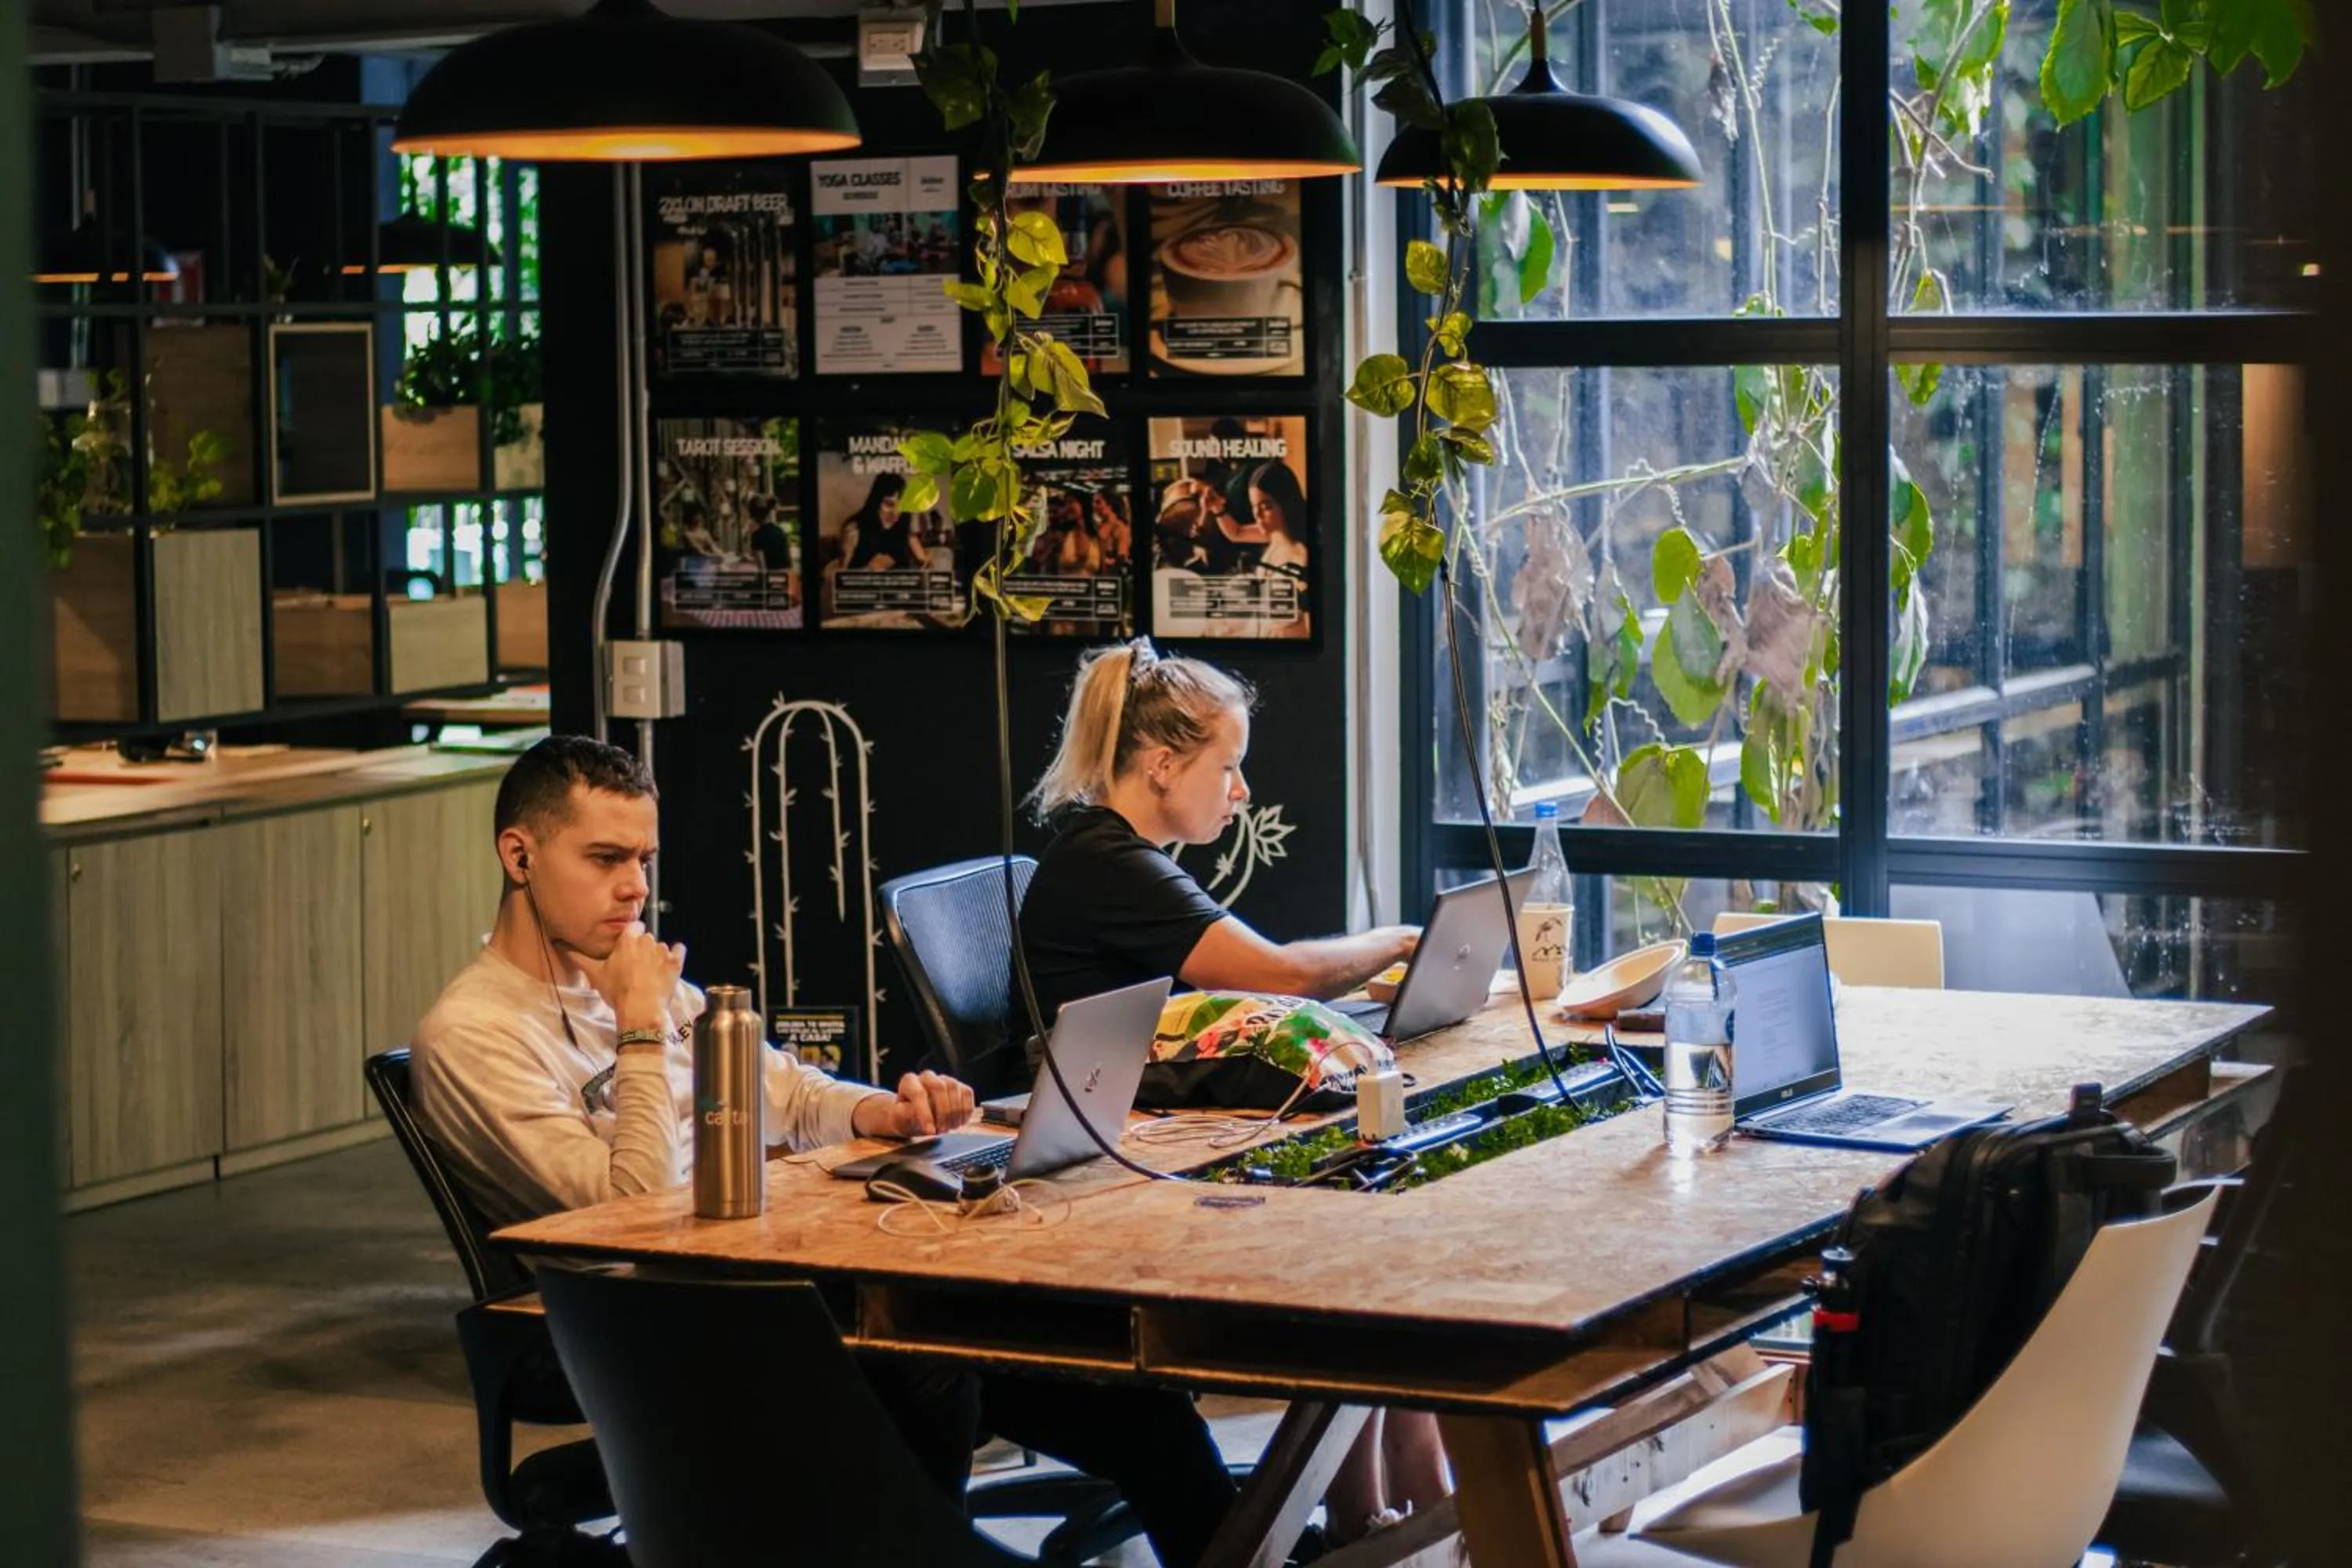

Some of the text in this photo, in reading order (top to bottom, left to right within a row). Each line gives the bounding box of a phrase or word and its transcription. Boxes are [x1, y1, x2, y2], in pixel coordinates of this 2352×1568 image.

[818, 172, 902, 188] YOGA CLASSES
[1167, 180, 1286, 197] COFFEE TASTING
[706, 195, 751, 212] DRAFT
[753, 194, 787, 212] BEER
[676, 437, 783, 456] TAROT SESSION
[1059, 440, 1105, 459] NIGHT
[1170, 438, 1288, 458] SOUND HEALING
